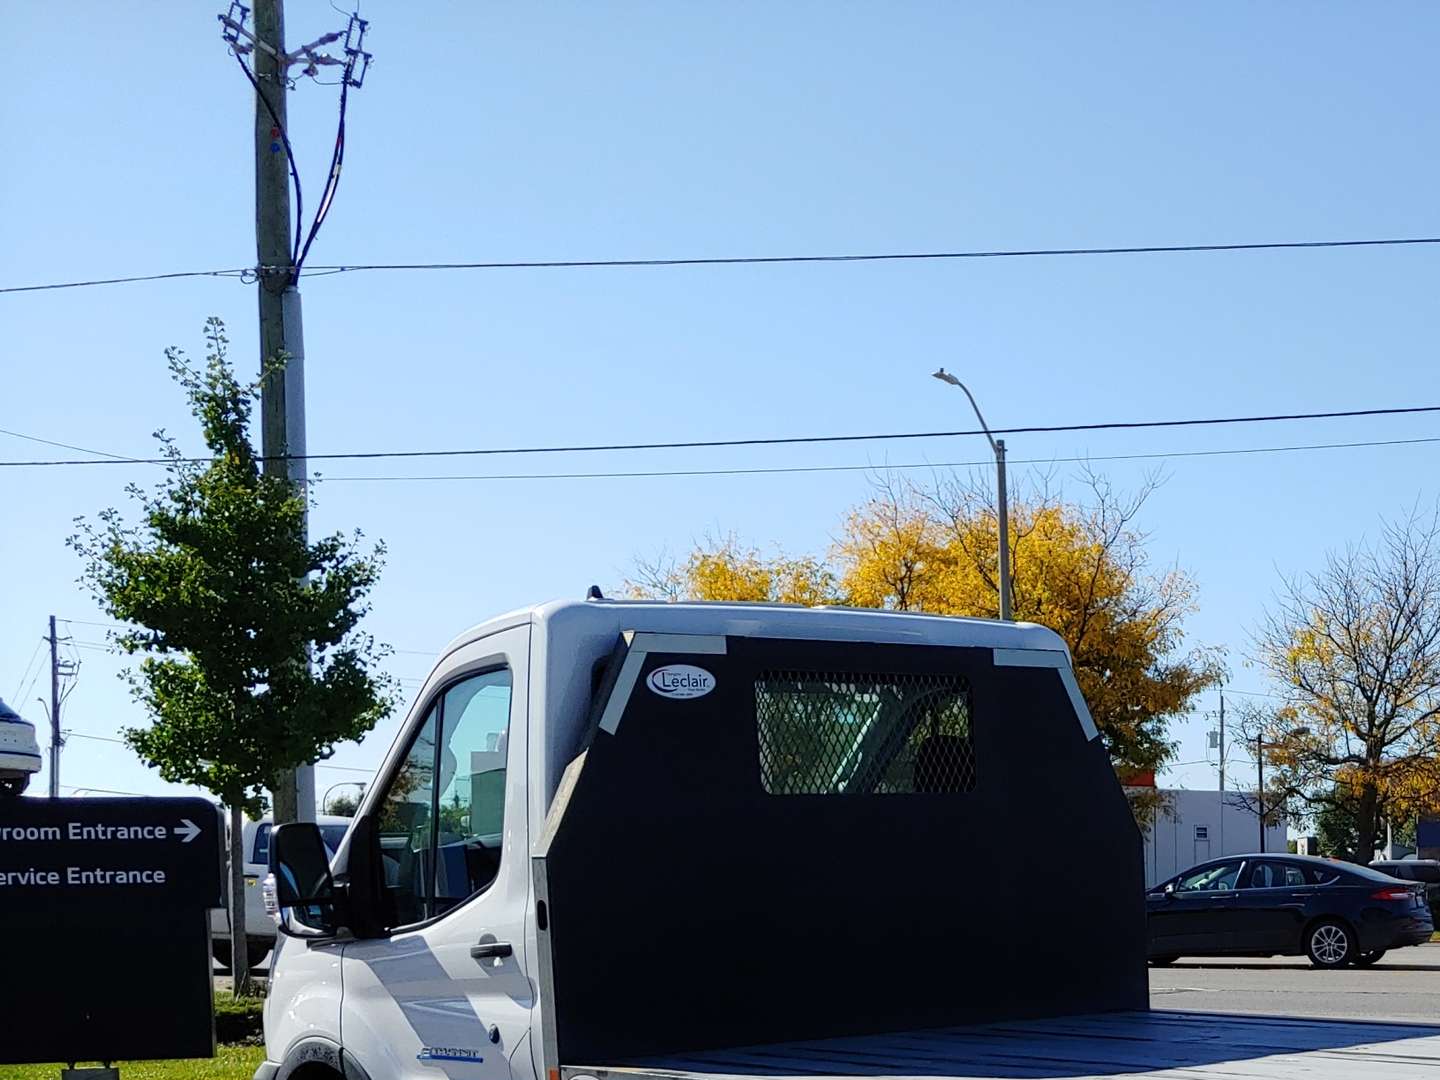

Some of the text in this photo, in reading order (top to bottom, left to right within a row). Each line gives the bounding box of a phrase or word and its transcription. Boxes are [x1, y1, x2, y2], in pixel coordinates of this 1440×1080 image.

[662, 672, 707, 688] Leclair
[0, 822, 167, 841] room Entrance
[66, 866, 166, 884] Entrance
